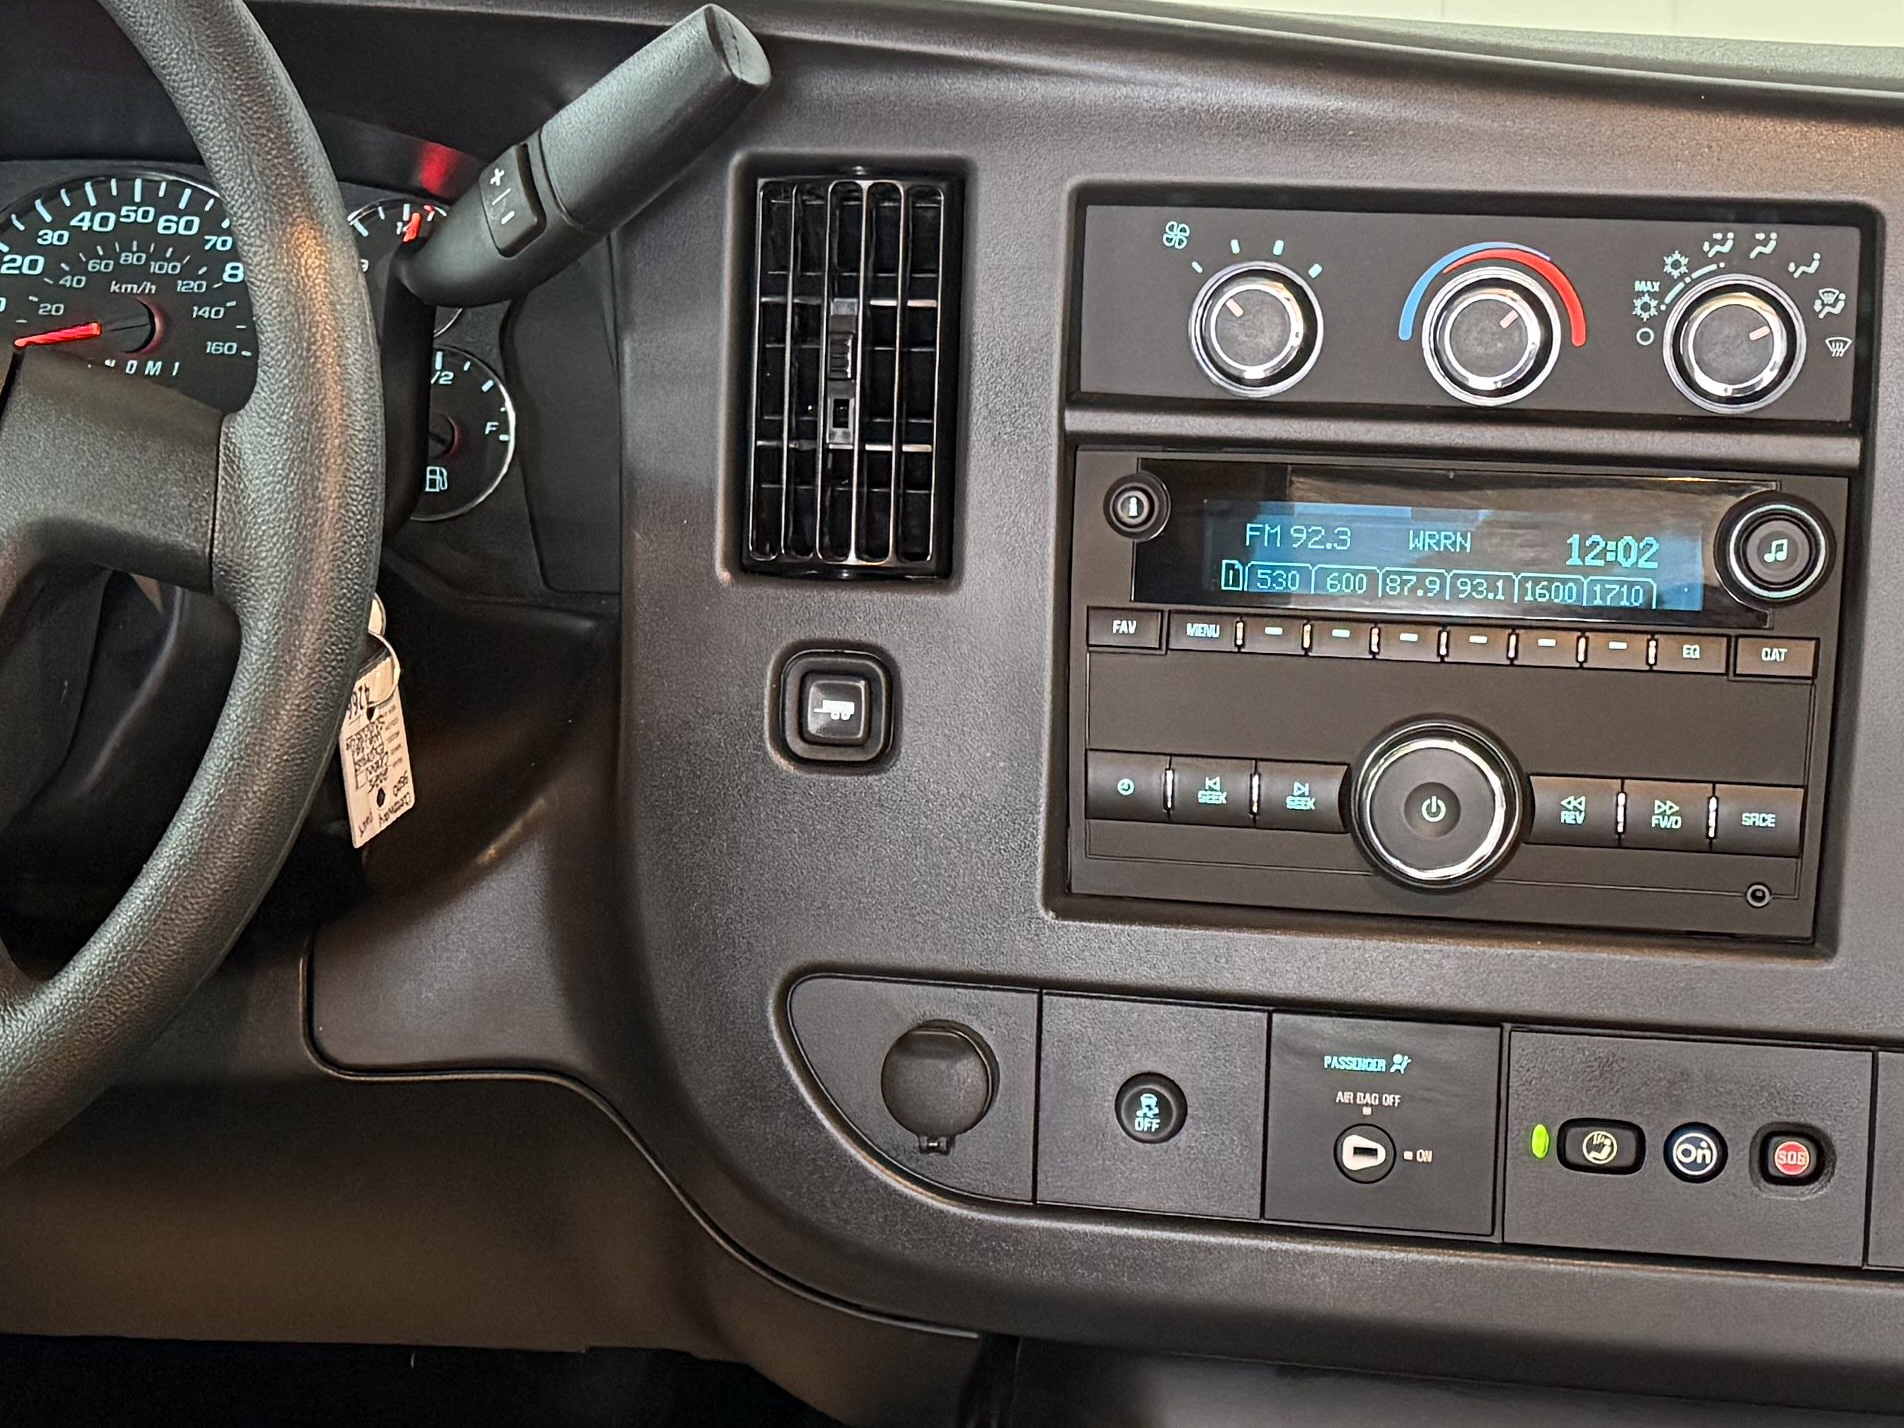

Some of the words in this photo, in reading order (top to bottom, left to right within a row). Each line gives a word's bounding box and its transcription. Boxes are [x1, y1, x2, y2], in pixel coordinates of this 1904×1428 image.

[70, 211, 116, 232] 40
[119, 206, 155, 223] 50
[157, 215, 200, 236] 60
[36, 229, 69, 246] 30
[203, 235, 233, 252] 70
[0, 255, 45, 275] 20
[87, 259, 114, 273] 60
[119, 252, 147, 265] 80
[149, 262, 181, 274] 100
[222, 262, 245, 283] 8
[58, 275, 86, 289] 40
[110, 280, 157, 294] km/h
[176, 279, 207, 293] 120
[1634, 280, 1660, 292] MAX
[37, 303, 65, 316] 20
[192, 306, 225, 319] 140
[205, 341, 238, 355] 160
[484, 422, 499, 435] F
[1245, 523, 1281, 548] FM
[1290, 525, 1352, 550] 92.3
[1409, 529, 1472, 553] WRRN
[1565, 533, 1660, 569] 12:02
[1256, 570, 1300, 590] 530
[1326, 573, 1367, 594] 600
[1386, 575, 1441, 597] 87.9
[1457, 578, 1506, 601] 93.1
[1524, 581, 1577, 603] 1600
[1593, 584, 1644, 607] 1710
[1112, 620, 1137, 634] FAV
[1186, 623, 1220, 638] MENU
[1198, 790, 1227, 804] SEEK
[1286, 795, 1315, 810] SEEK
[1560, 810, 1586, 825] REV
[1651, 814, 1682, 829] FWD
[1741, 812, 1776, 828] SRCE
[1323, 1055, 1387, 1072] PASSENGER
[1336, 1090, 1354, 1104] AIR
[1356, 1092, 1379, 1106] BAG
[1382, 1093, 1402, 1107] OFF
[1135, 1117, 1161, 1132] OFF
[1416, 1149, 1433, 1163] ON
[1777, 1148, 1807, 1166] SOS
